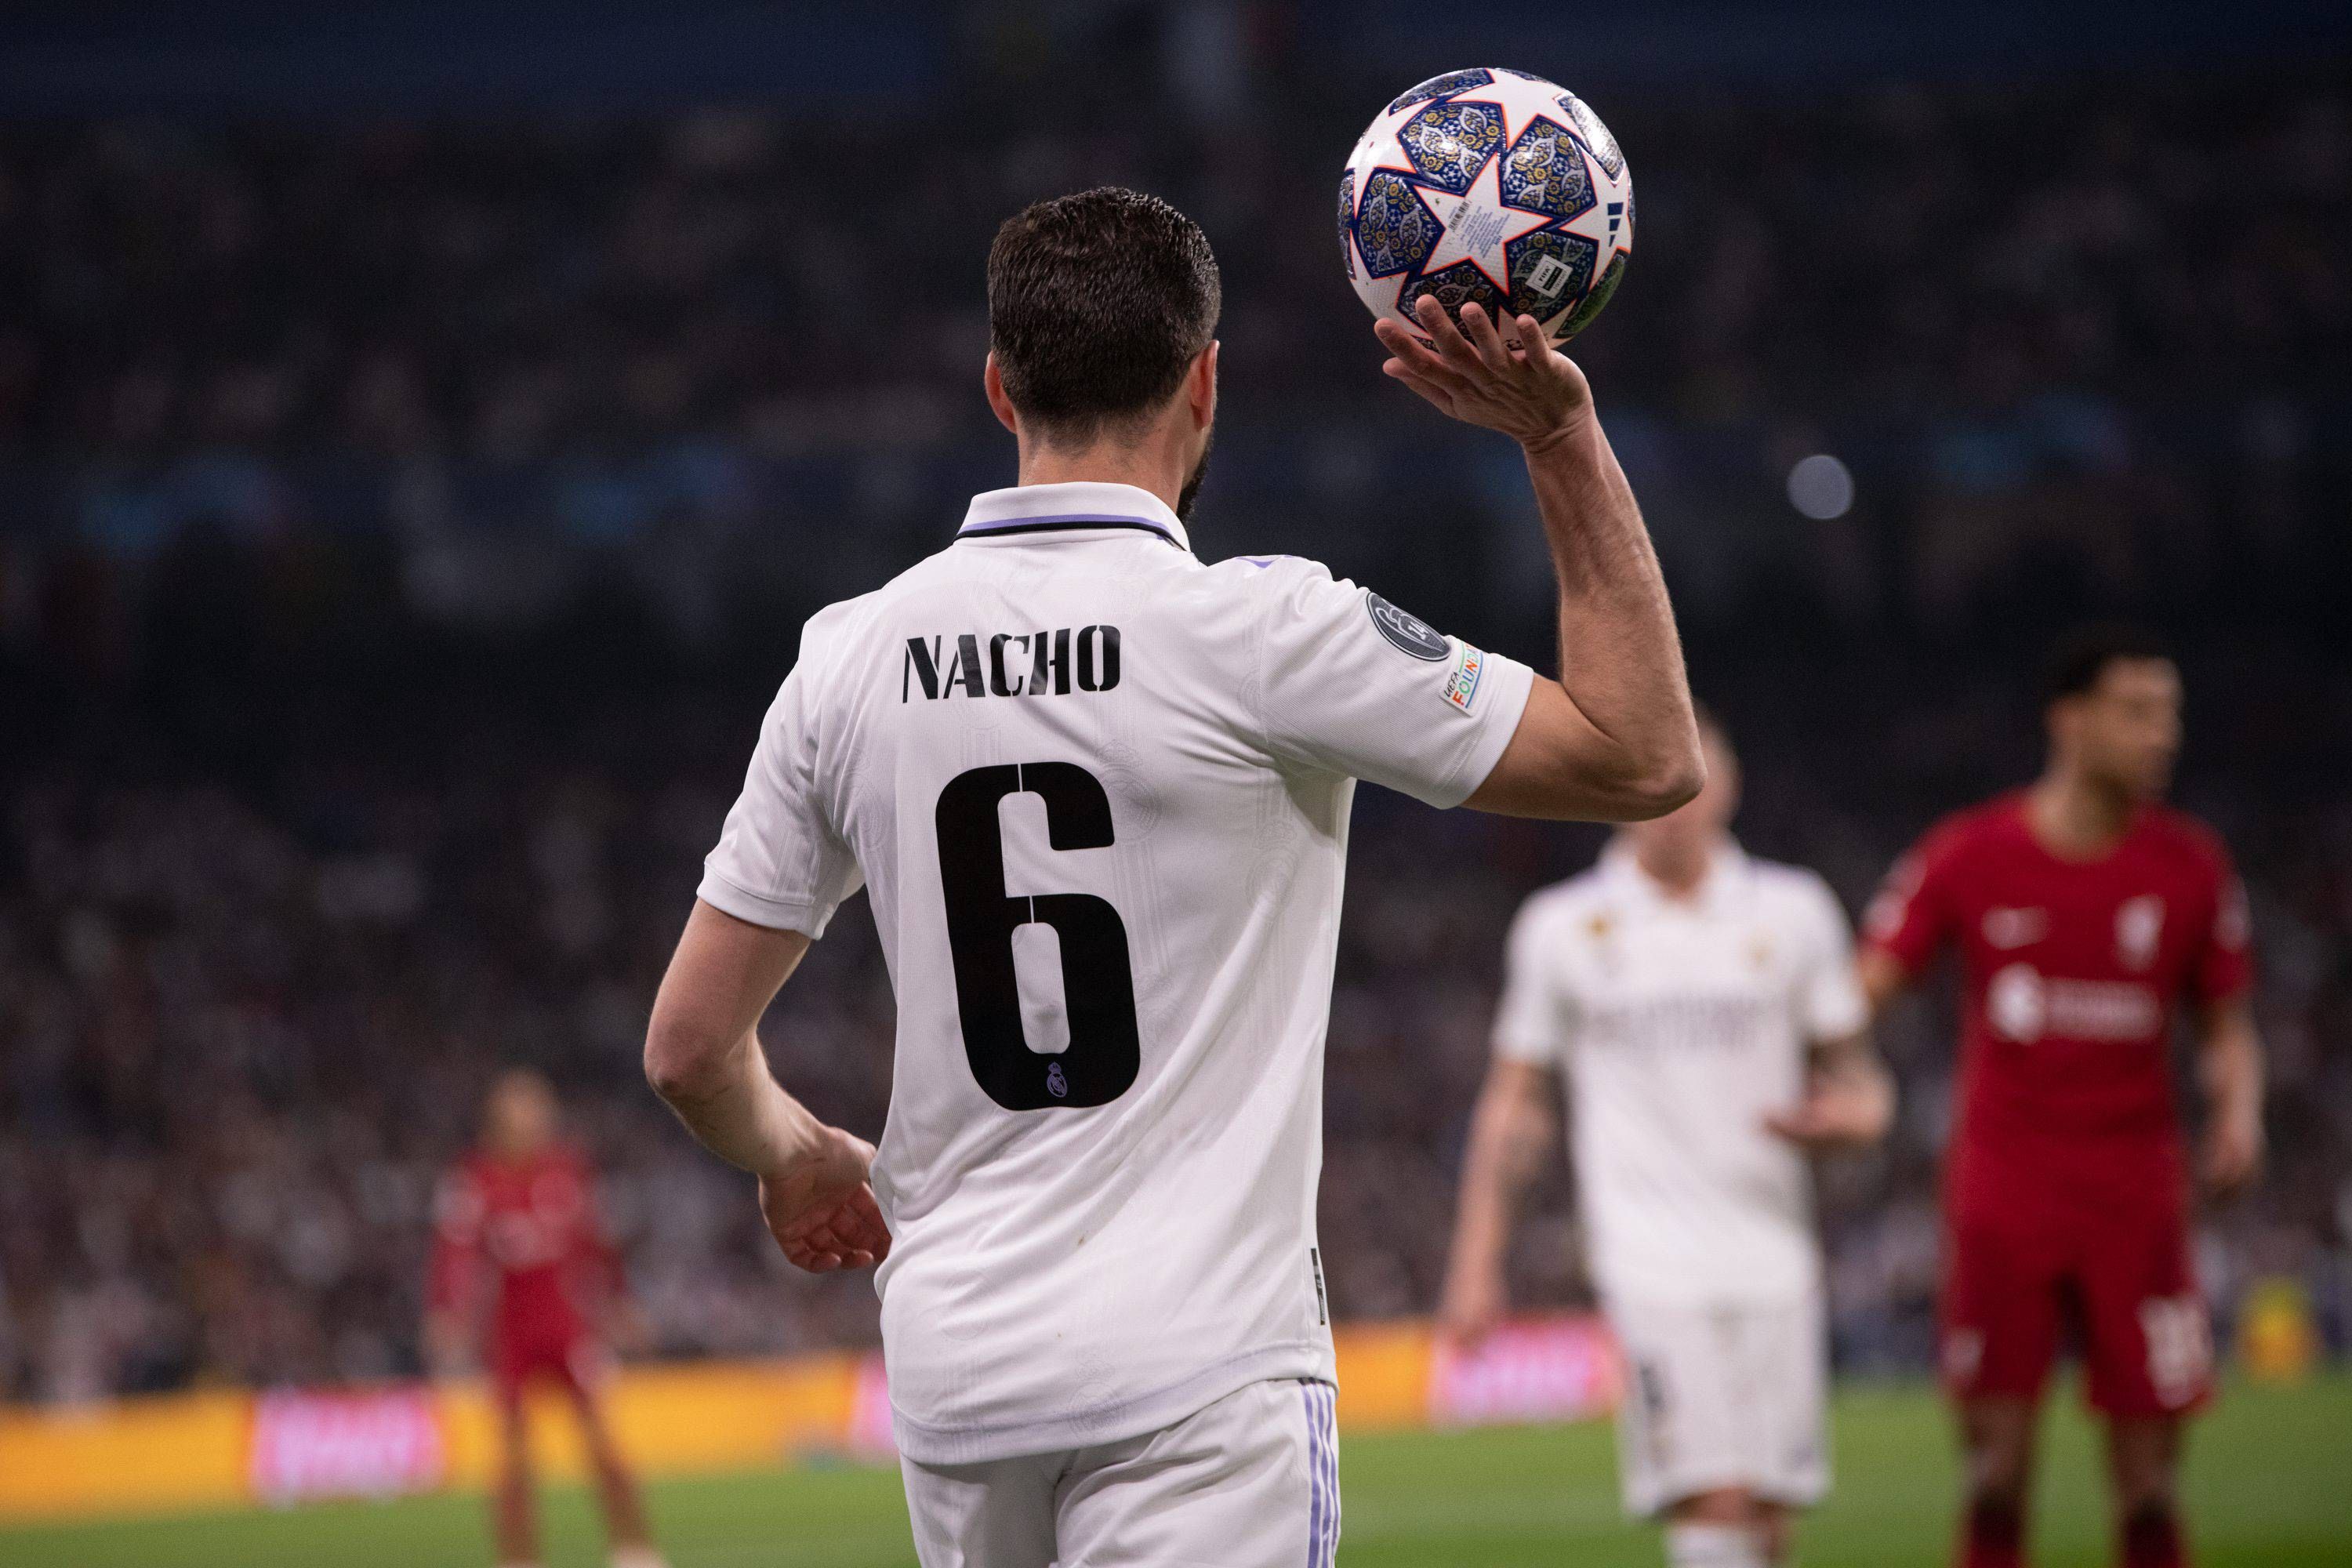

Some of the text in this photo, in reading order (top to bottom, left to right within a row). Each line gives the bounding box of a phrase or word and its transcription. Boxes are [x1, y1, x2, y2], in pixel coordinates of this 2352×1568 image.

[1538, 268, 1550, 282] FIFA
[902, 625, 1121, 703] NACHO
[1444, 671, 1460, 697] UEFA
[935, 761, 1141, 1111] 6
